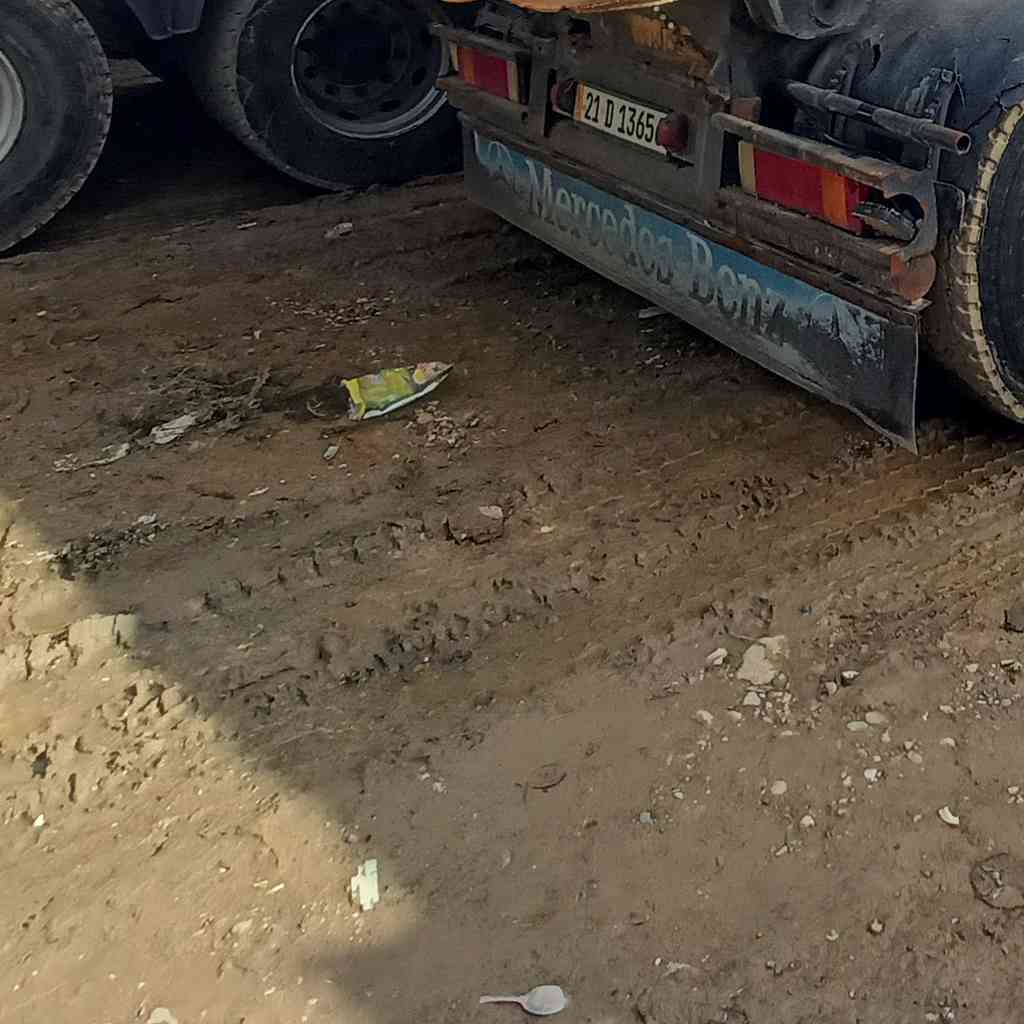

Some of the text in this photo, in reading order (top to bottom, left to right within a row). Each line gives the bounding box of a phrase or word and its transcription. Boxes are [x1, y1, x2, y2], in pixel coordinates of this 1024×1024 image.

[584, 92, 655, 143] 21 D 1365
